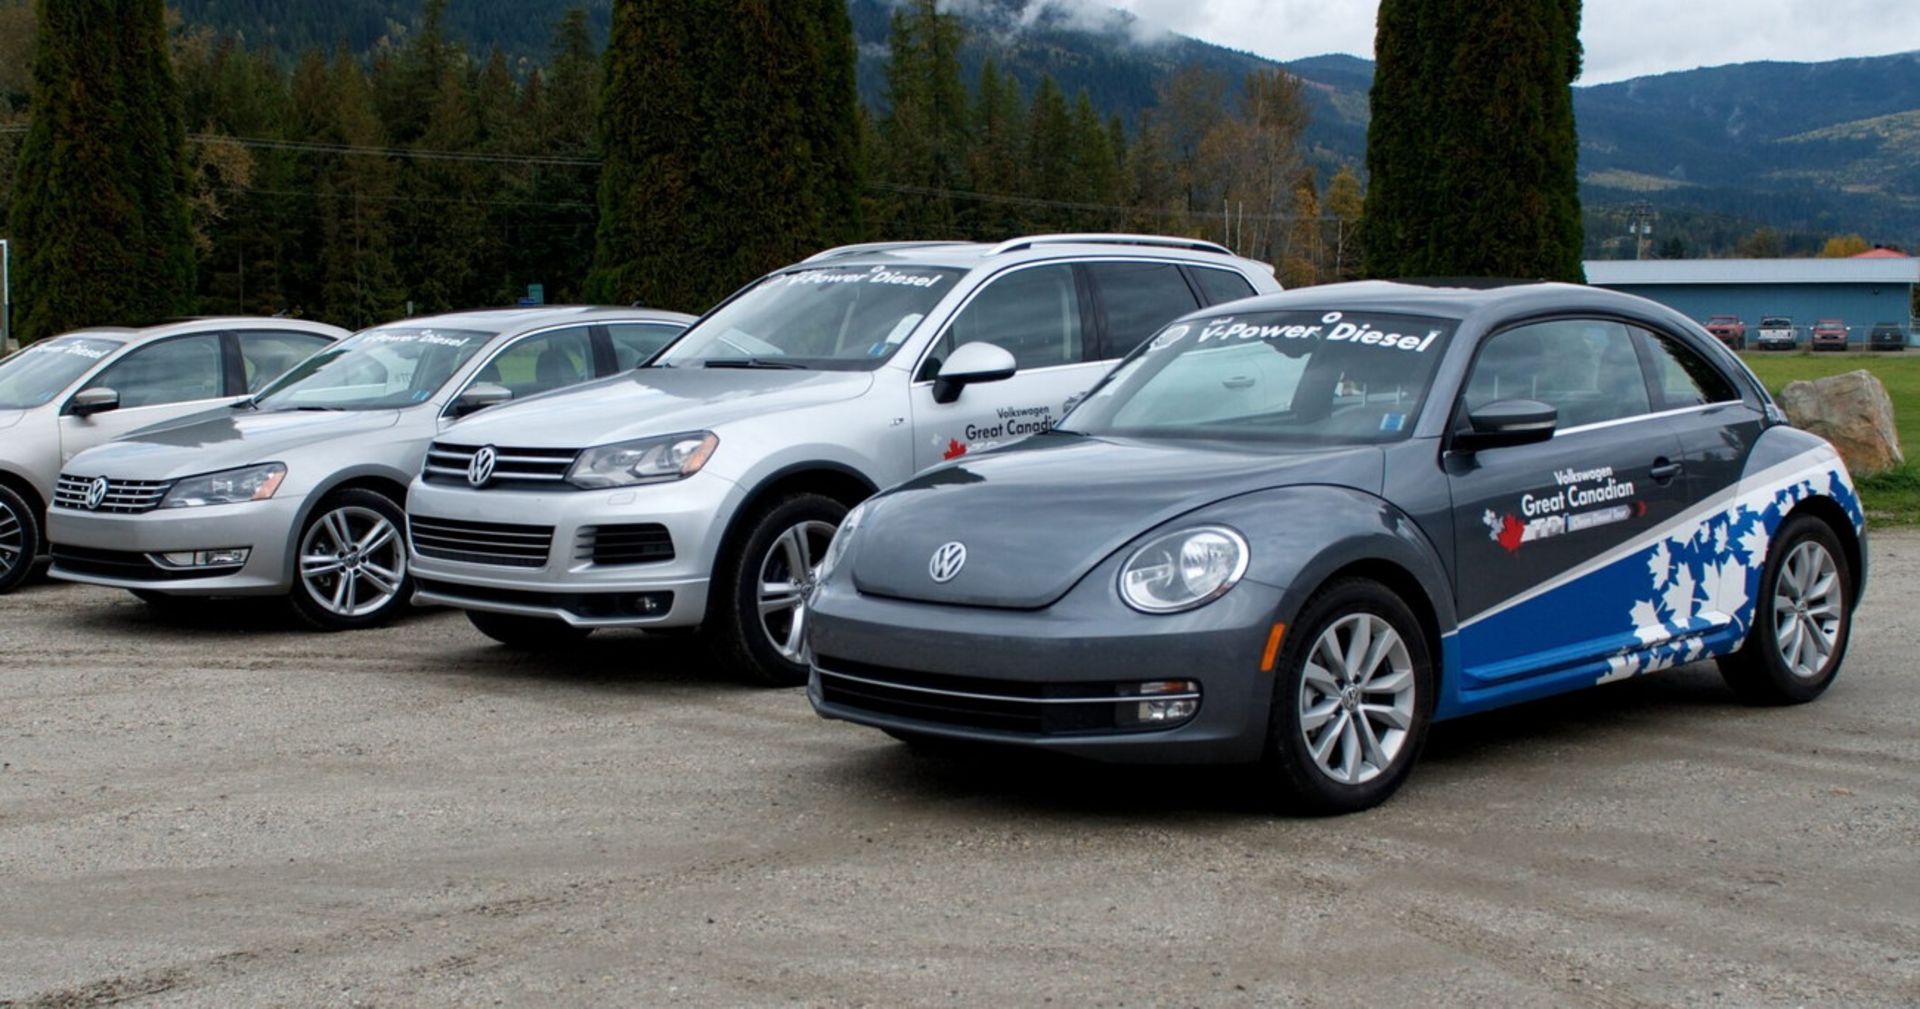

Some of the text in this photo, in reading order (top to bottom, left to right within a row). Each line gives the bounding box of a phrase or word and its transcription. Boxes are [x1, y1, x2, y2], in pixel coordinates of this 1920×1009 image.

[869, 271, 943, 288] Diesel
[1198, 322, 1440, 353] V-Power Diesel
[997, 405, 1050, 420] Volkswagen
[965, 416, 1058, 441] Great Canadi
[1553, 466, 1613, 486] Volkswagen
[1521, 477, 1635, 516] Great Canadian
